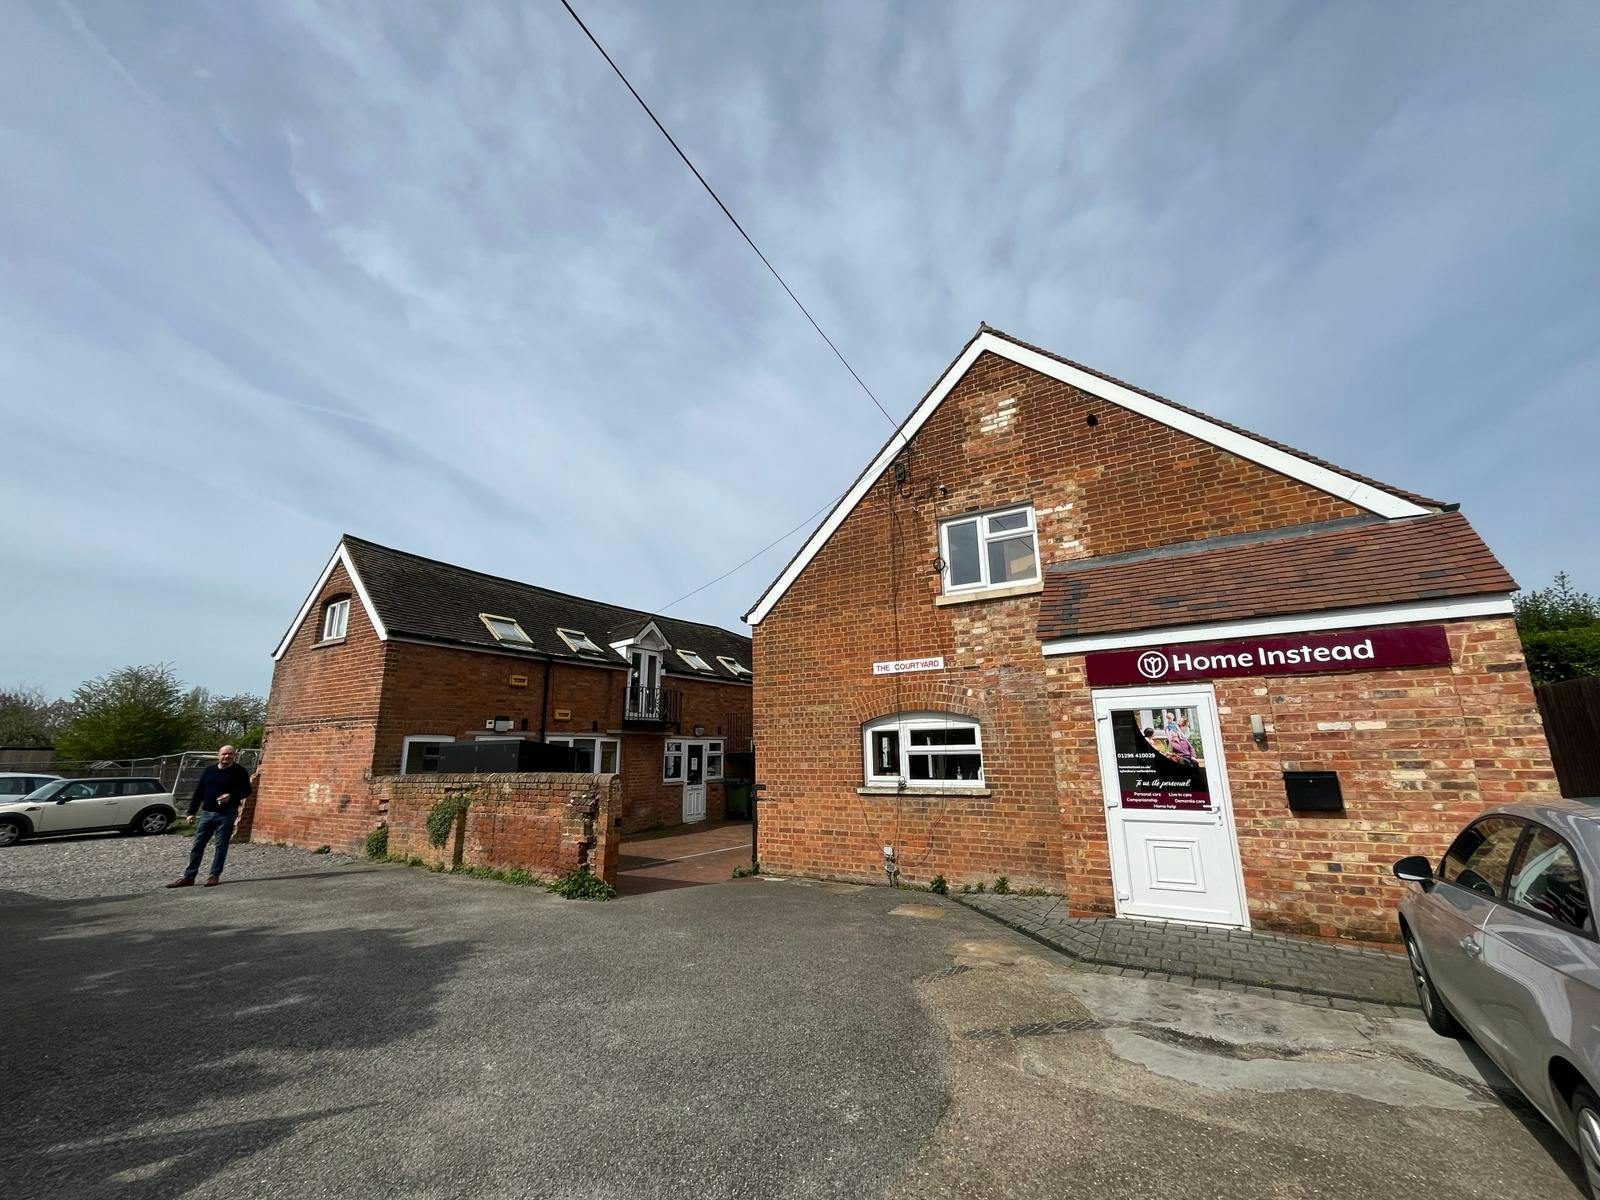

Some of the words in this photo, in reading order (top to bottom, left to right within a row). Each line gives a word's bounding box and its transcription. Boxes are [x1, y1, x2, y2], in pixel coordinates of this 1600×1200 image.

[1172, 653, 1254, 672] Home
[1258, 639, 1375, 666] Instead
[894, 660, 940, 671] COURTYARD
[1158, 778, 1192, 789] personal
